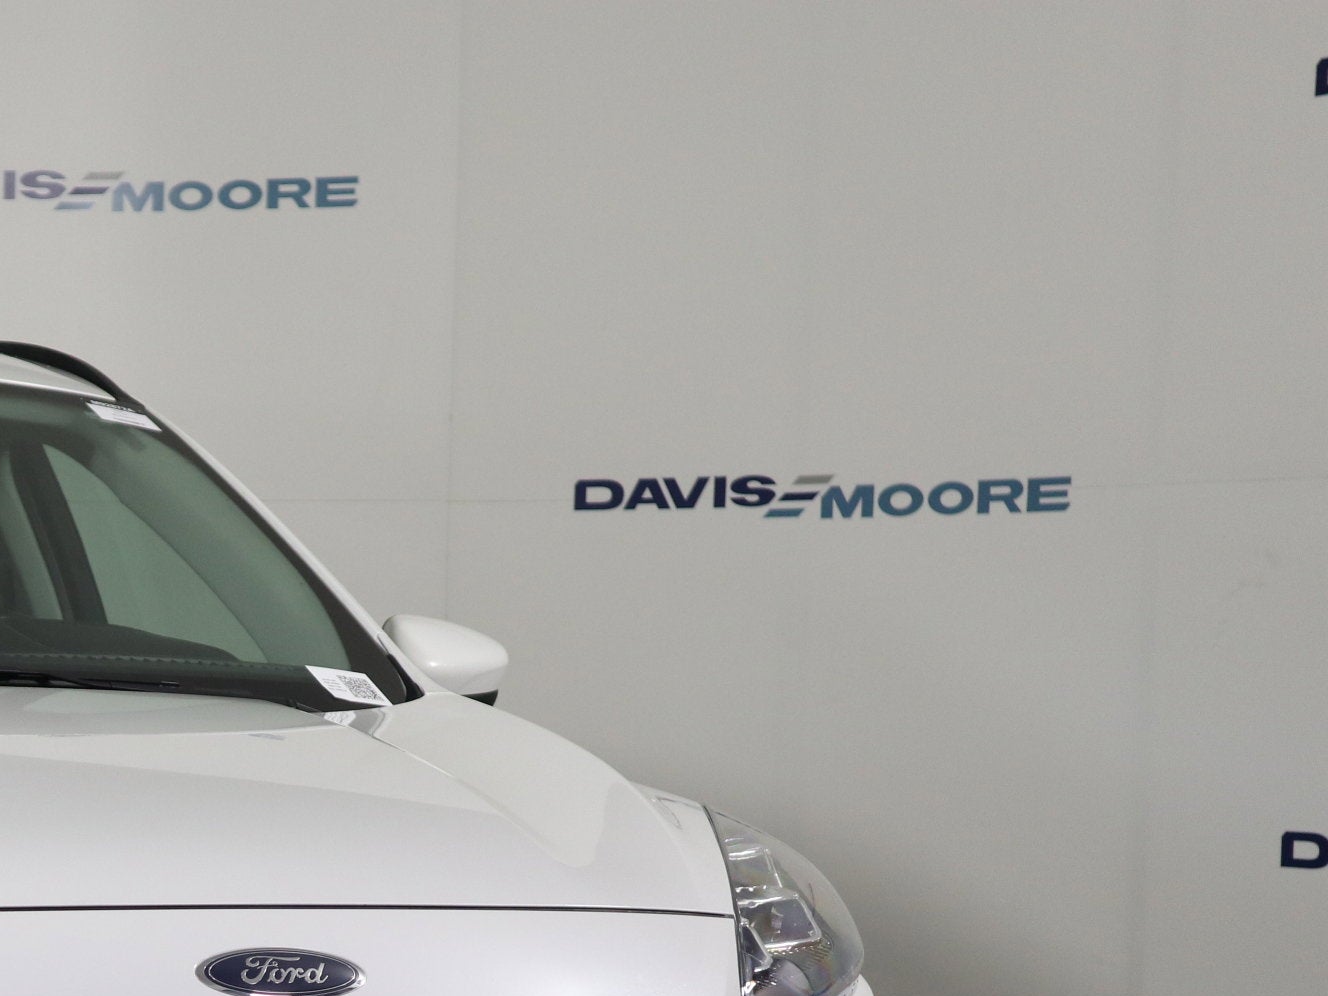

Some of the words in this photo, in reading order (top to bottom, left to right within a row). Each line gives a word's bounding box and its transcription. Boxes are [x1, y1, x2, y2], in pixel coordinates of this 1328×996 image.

[111, 176, 360, 212] MOORE
[573, 474, 777, 511] DAVIS
[819, 476, 1072, 519] MOORE
[240, 955, 329, 985] Ford
